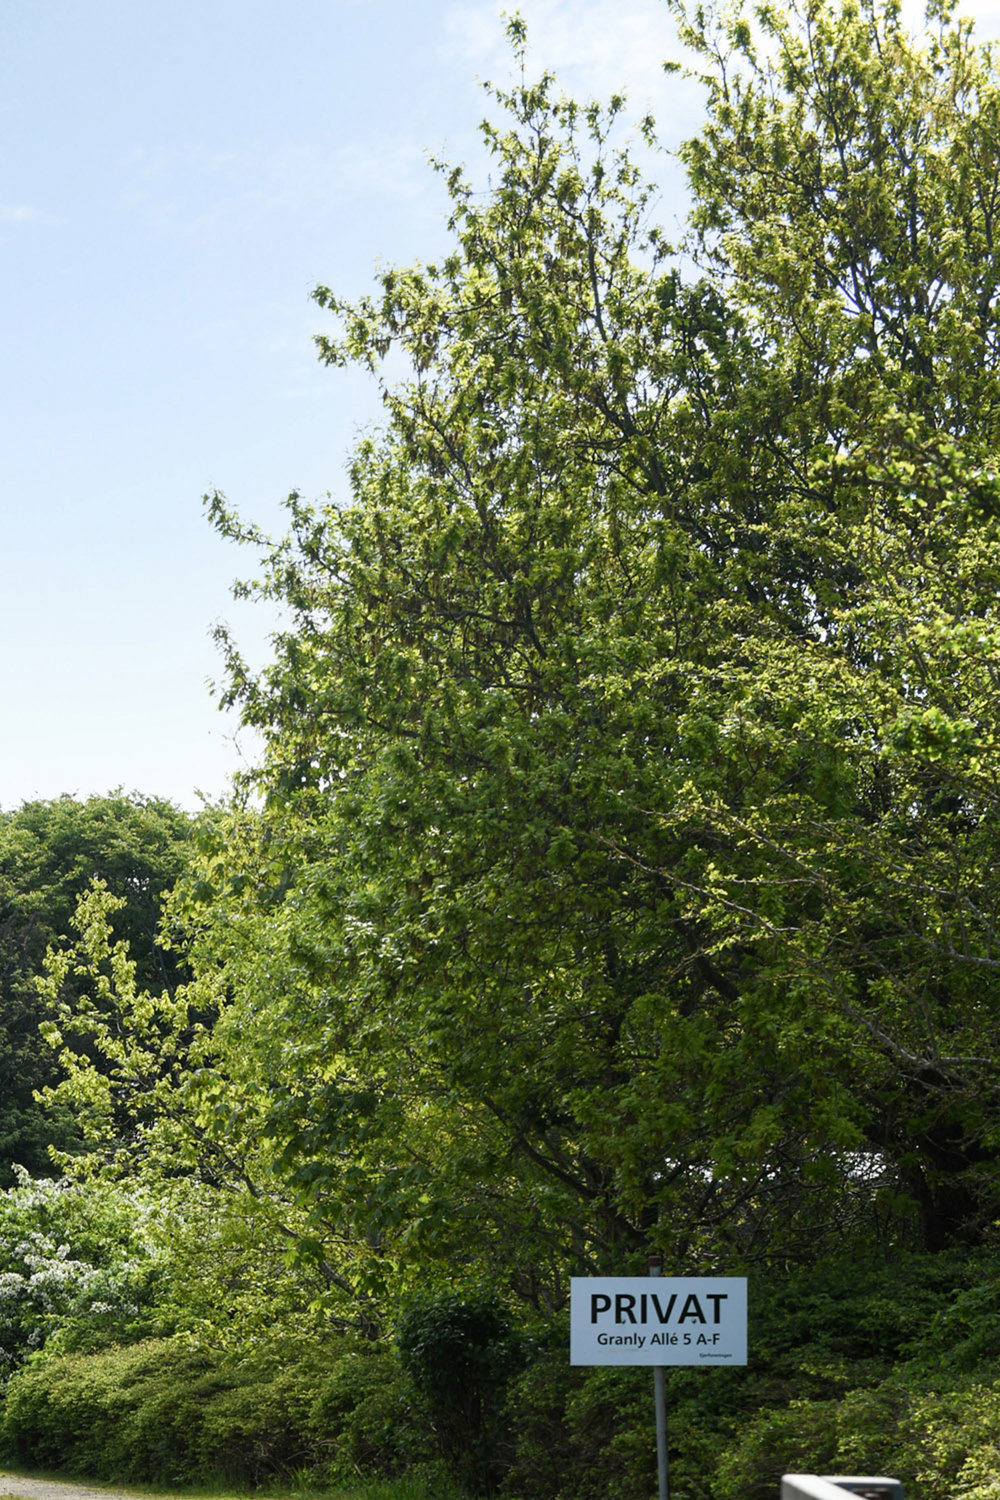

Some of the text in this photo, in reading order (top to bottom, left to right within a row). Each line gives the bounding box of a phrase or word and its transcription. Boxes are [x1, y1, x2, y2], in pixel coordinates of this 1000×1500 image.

[591, 1294, 728, 1324] PRIVAT
[597, 1332, 720, 1348] Granly Allé 5 A-F
